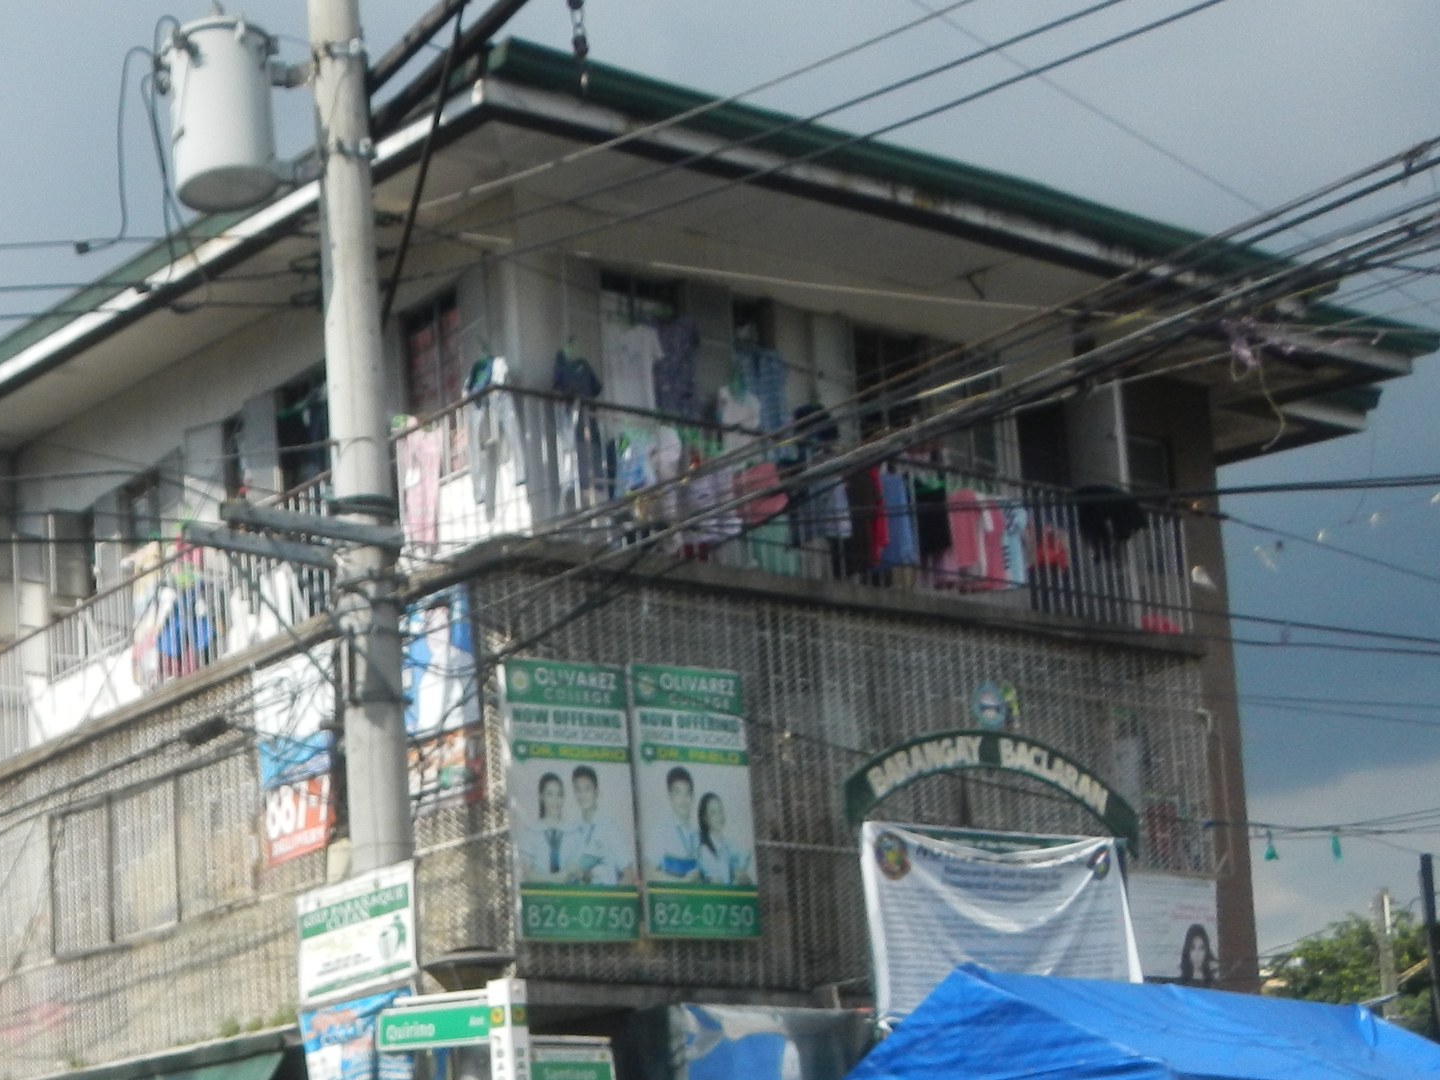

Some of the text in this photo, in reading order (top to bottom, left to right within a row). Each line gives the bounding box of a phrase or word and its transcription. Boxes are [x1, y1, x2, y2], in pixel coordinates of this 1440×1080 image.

[534, 666, 618, 690] OLIVAREZ
[660, 672, 736, 697] OLIVAREZ
[512, 708, 623, 729] NOW OFFERING
[640, 711, 740, 734] NOW OFFERING
[866, 735, 1109, 817] BARANGAY BACLARAN
[526, 904, 636, 929] 826-0750
[653, 902, 755, 927] 826-0750
[385, 1021, 436, 1043] Quirino
